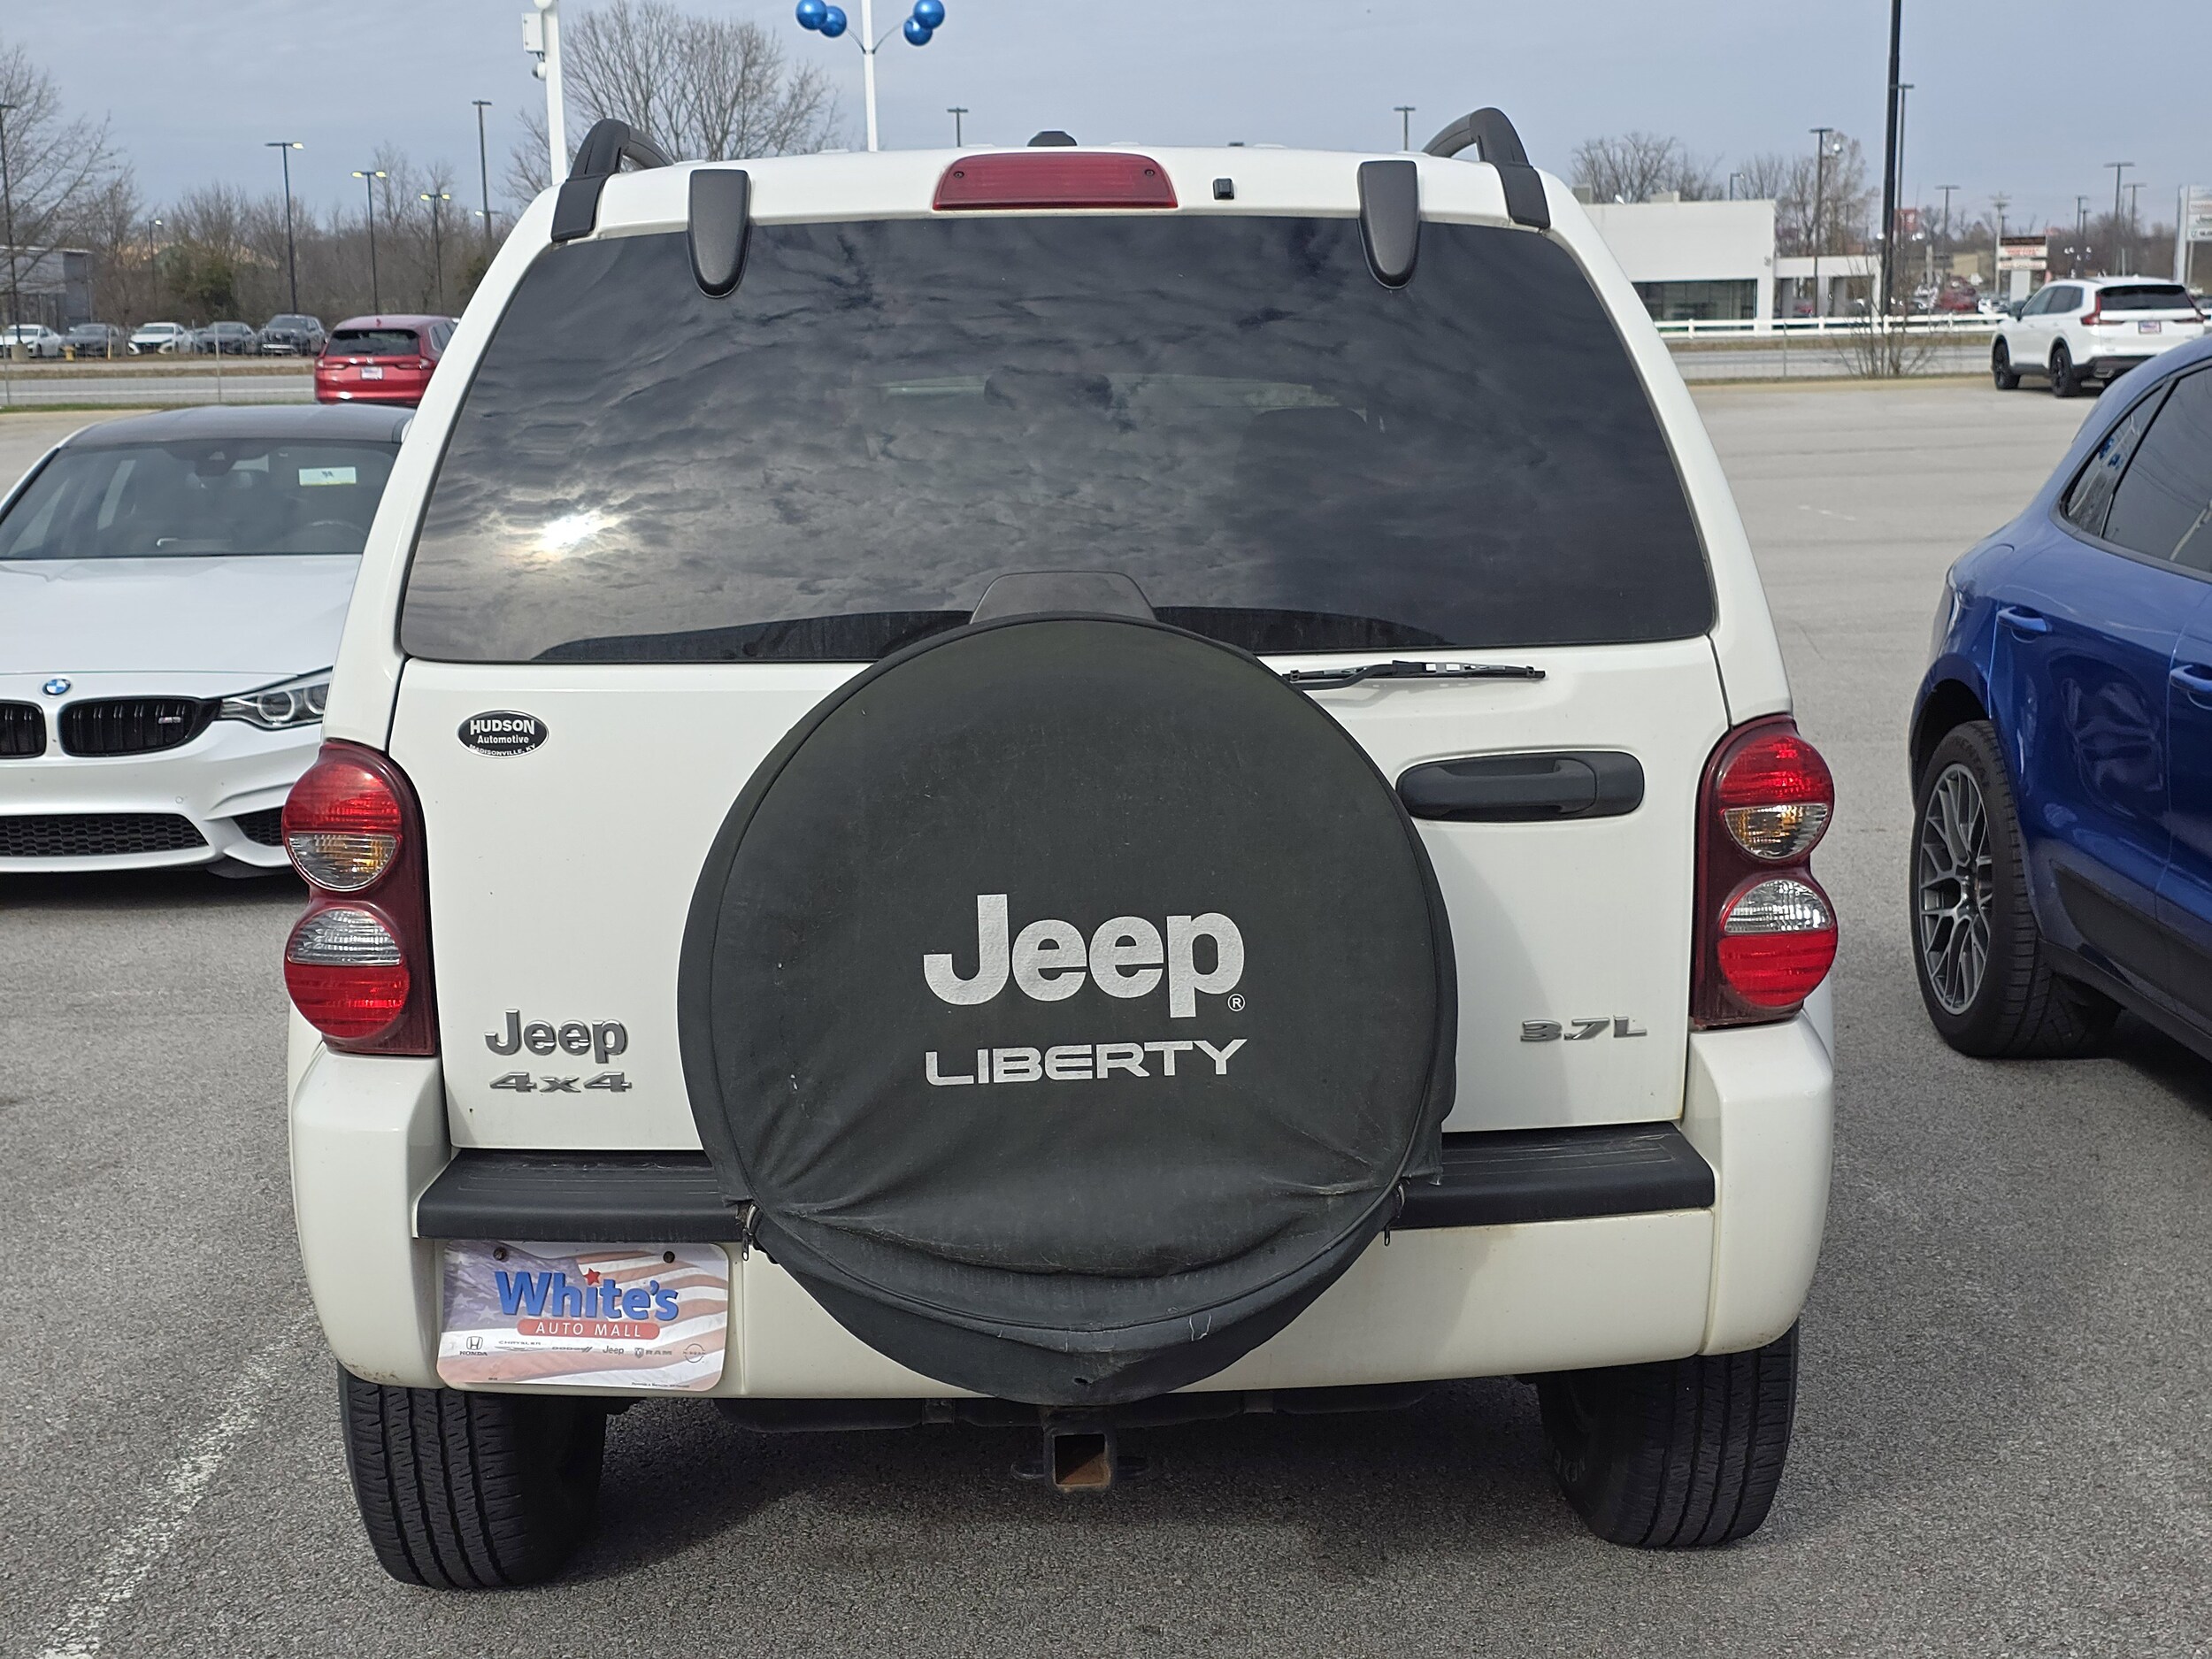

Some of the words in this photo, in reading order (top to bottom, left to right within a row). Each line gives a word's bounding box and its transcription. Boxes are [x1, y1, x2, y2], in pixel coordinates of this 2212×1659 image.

[470, 719, 534, 735] HUDSON
[477, 734, 529, 744] Automotive
[526, 743, 535, 752] KY
[923, 894, 1245, 1018] Jeep
[485, 1009, 629, 1064] Jeep
[1520, 1016, 1647, 1042] 3.7L
[926, 1038, 1248, 1087] LIBERTY
[489, 1071, 633, 1093] 4x4
[495, 1271, 680, 1321] White's
[535, 1321, 584, 1335] AUTO
[594, 1324, 641, 1338] MALL
[603, 1345, 625, 1356] Jeep
